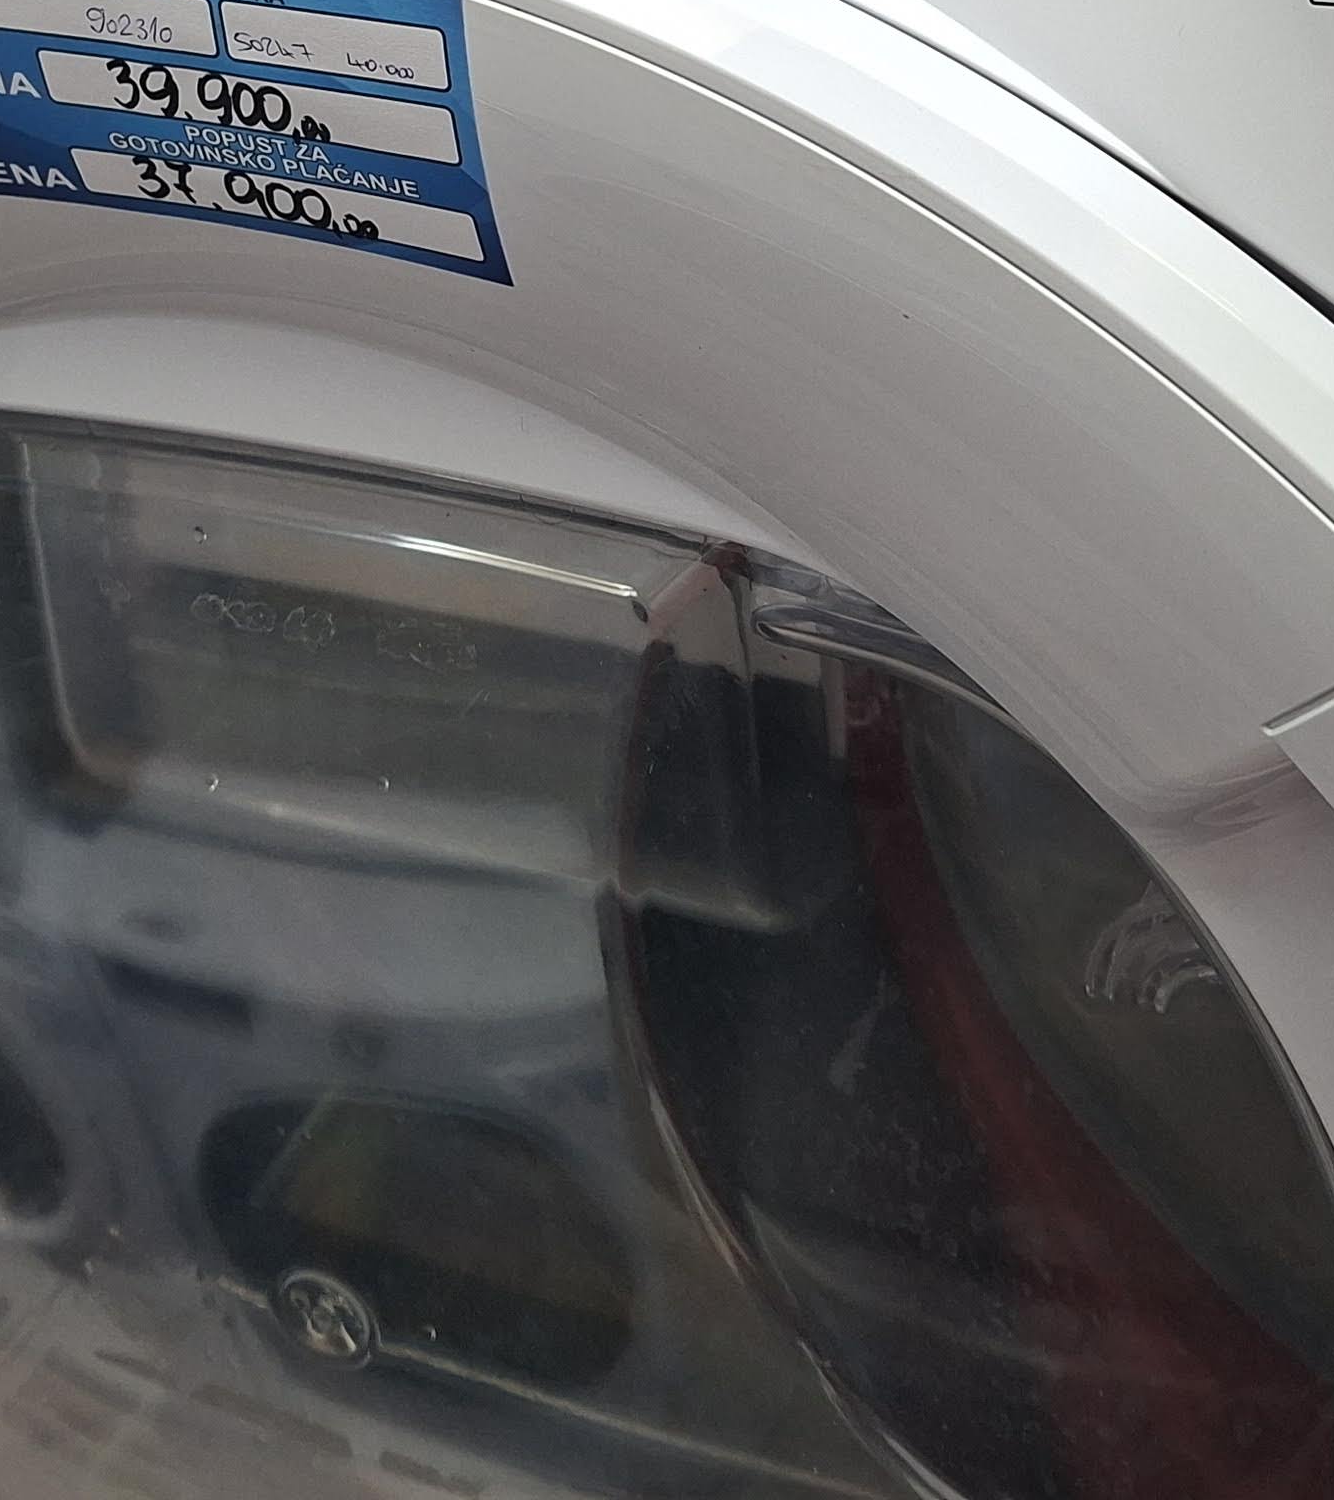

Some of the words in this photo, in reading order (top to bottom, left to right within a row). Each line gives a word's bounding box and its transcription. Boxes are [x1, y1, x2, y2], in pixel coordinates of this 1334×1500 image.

[108, 132, 276, 173] GOTOVINSKO
[284, 159, 420, 199] PLAĆANJE
[183, 124, 286, 157] POPUST
[295, 143, 330, 165] ZA
